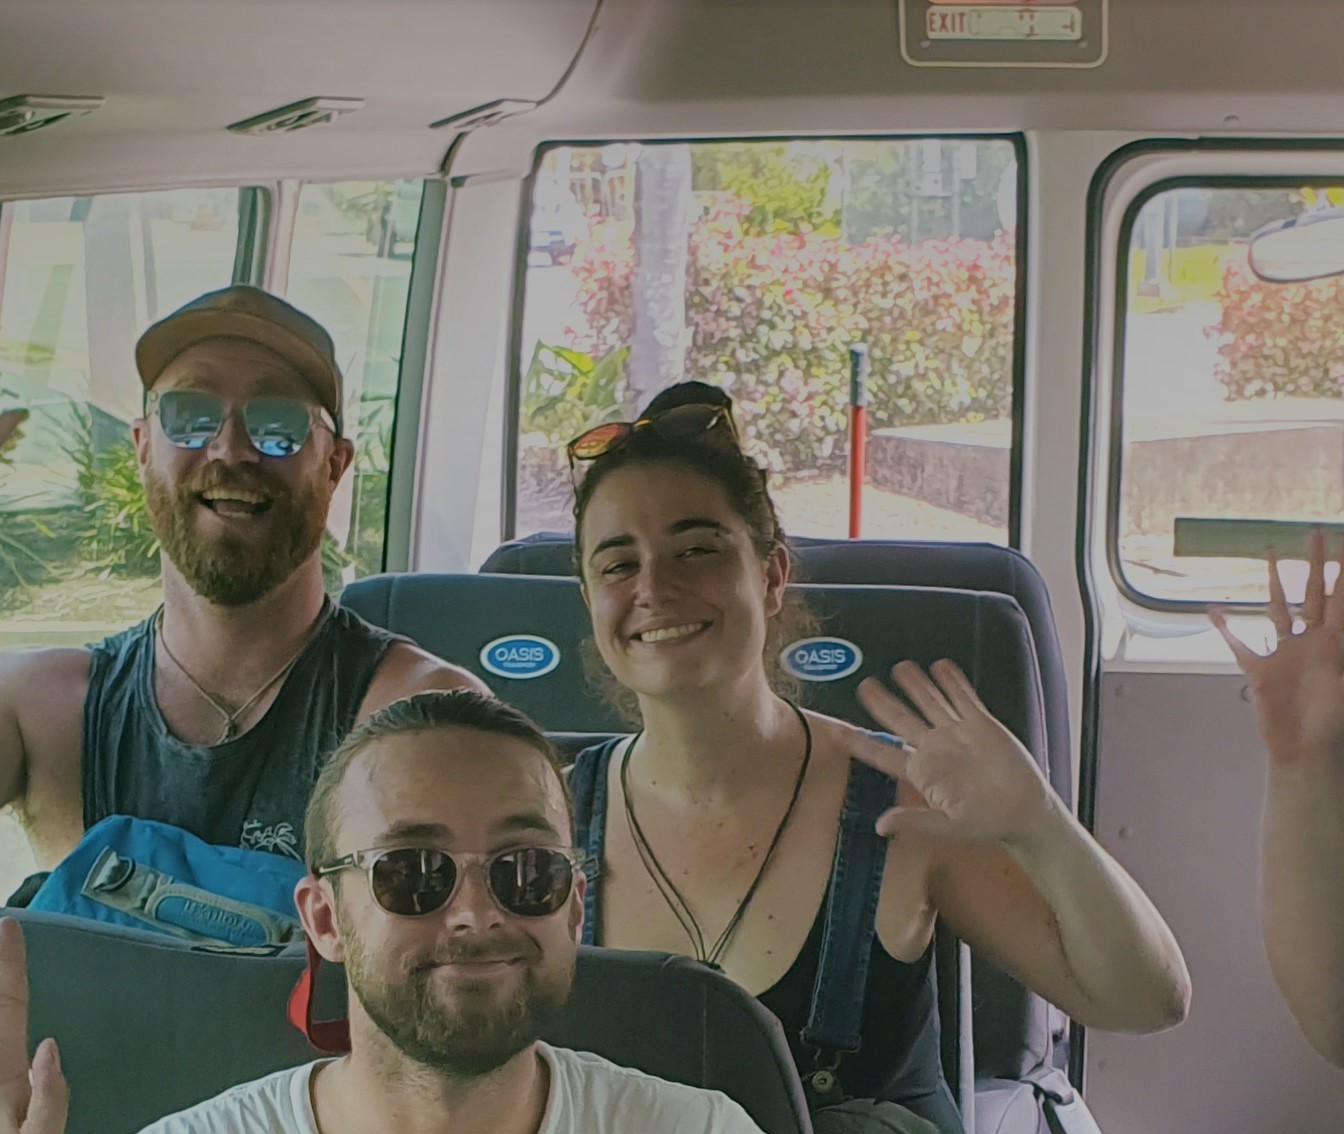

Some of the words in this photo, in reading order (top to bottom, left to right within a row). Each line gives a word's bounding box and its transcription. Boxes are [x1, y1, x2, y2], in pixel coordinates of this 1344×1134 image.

[928, 12, 967, 33] EXIT
[495, 647, 544, 661] OASIS
[795, 649, 846, 664] OASIS
